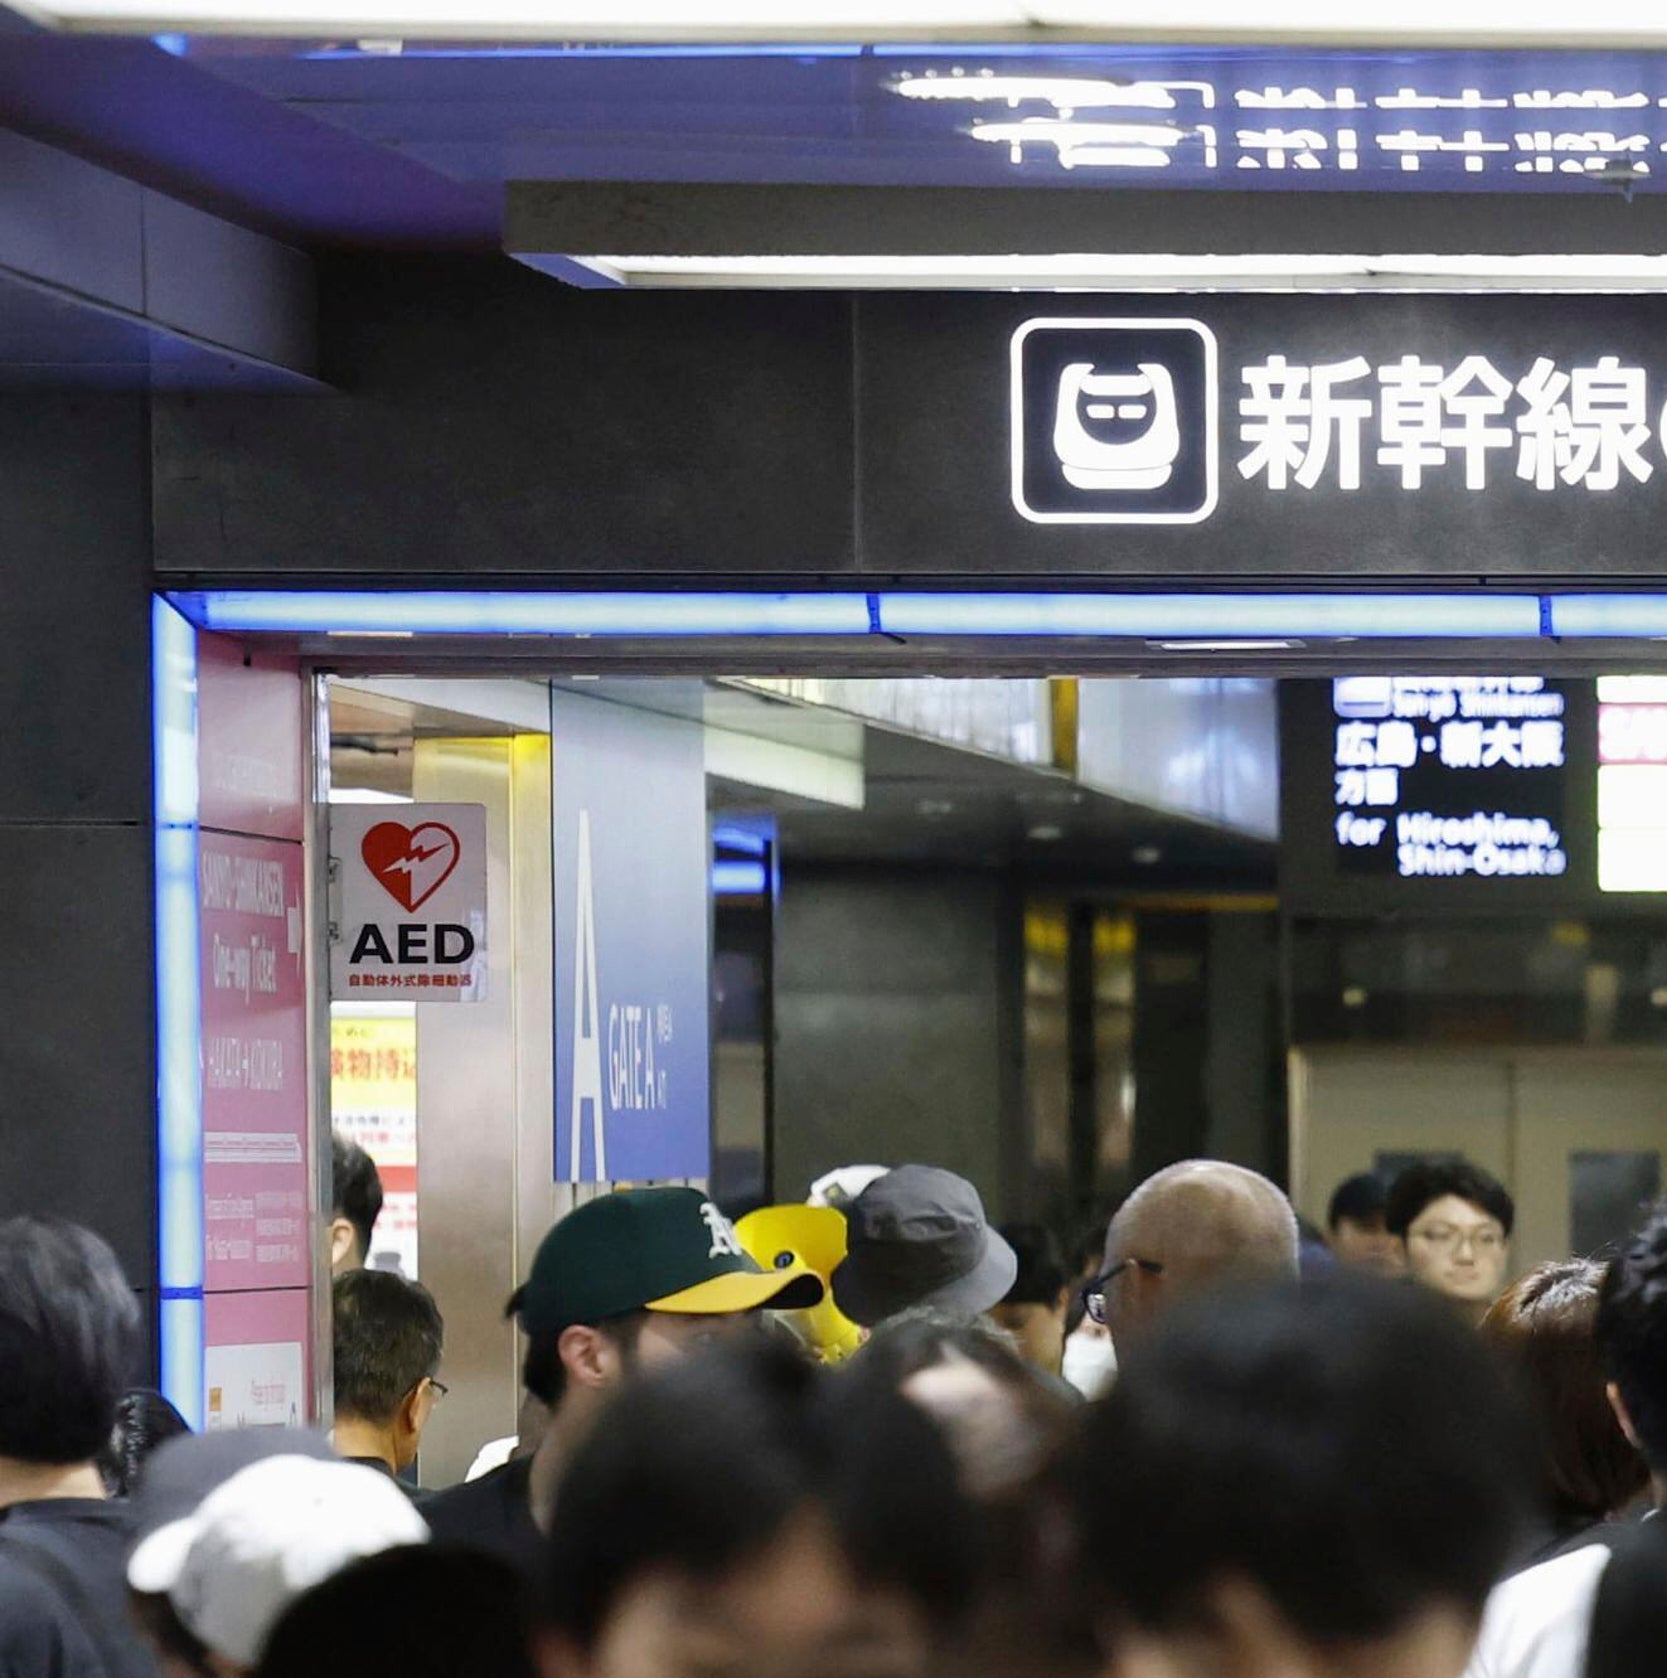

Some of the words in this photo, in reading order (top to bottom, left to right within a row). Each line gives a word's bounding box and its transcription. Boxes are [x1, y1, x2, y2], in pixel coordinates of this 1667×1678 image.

[1336, 811, 1387, 846] for
[349, 923, 475, 965] AED
[608, 1003, 643, 1111] GATE
[644, 1006, 656, 1110] A
